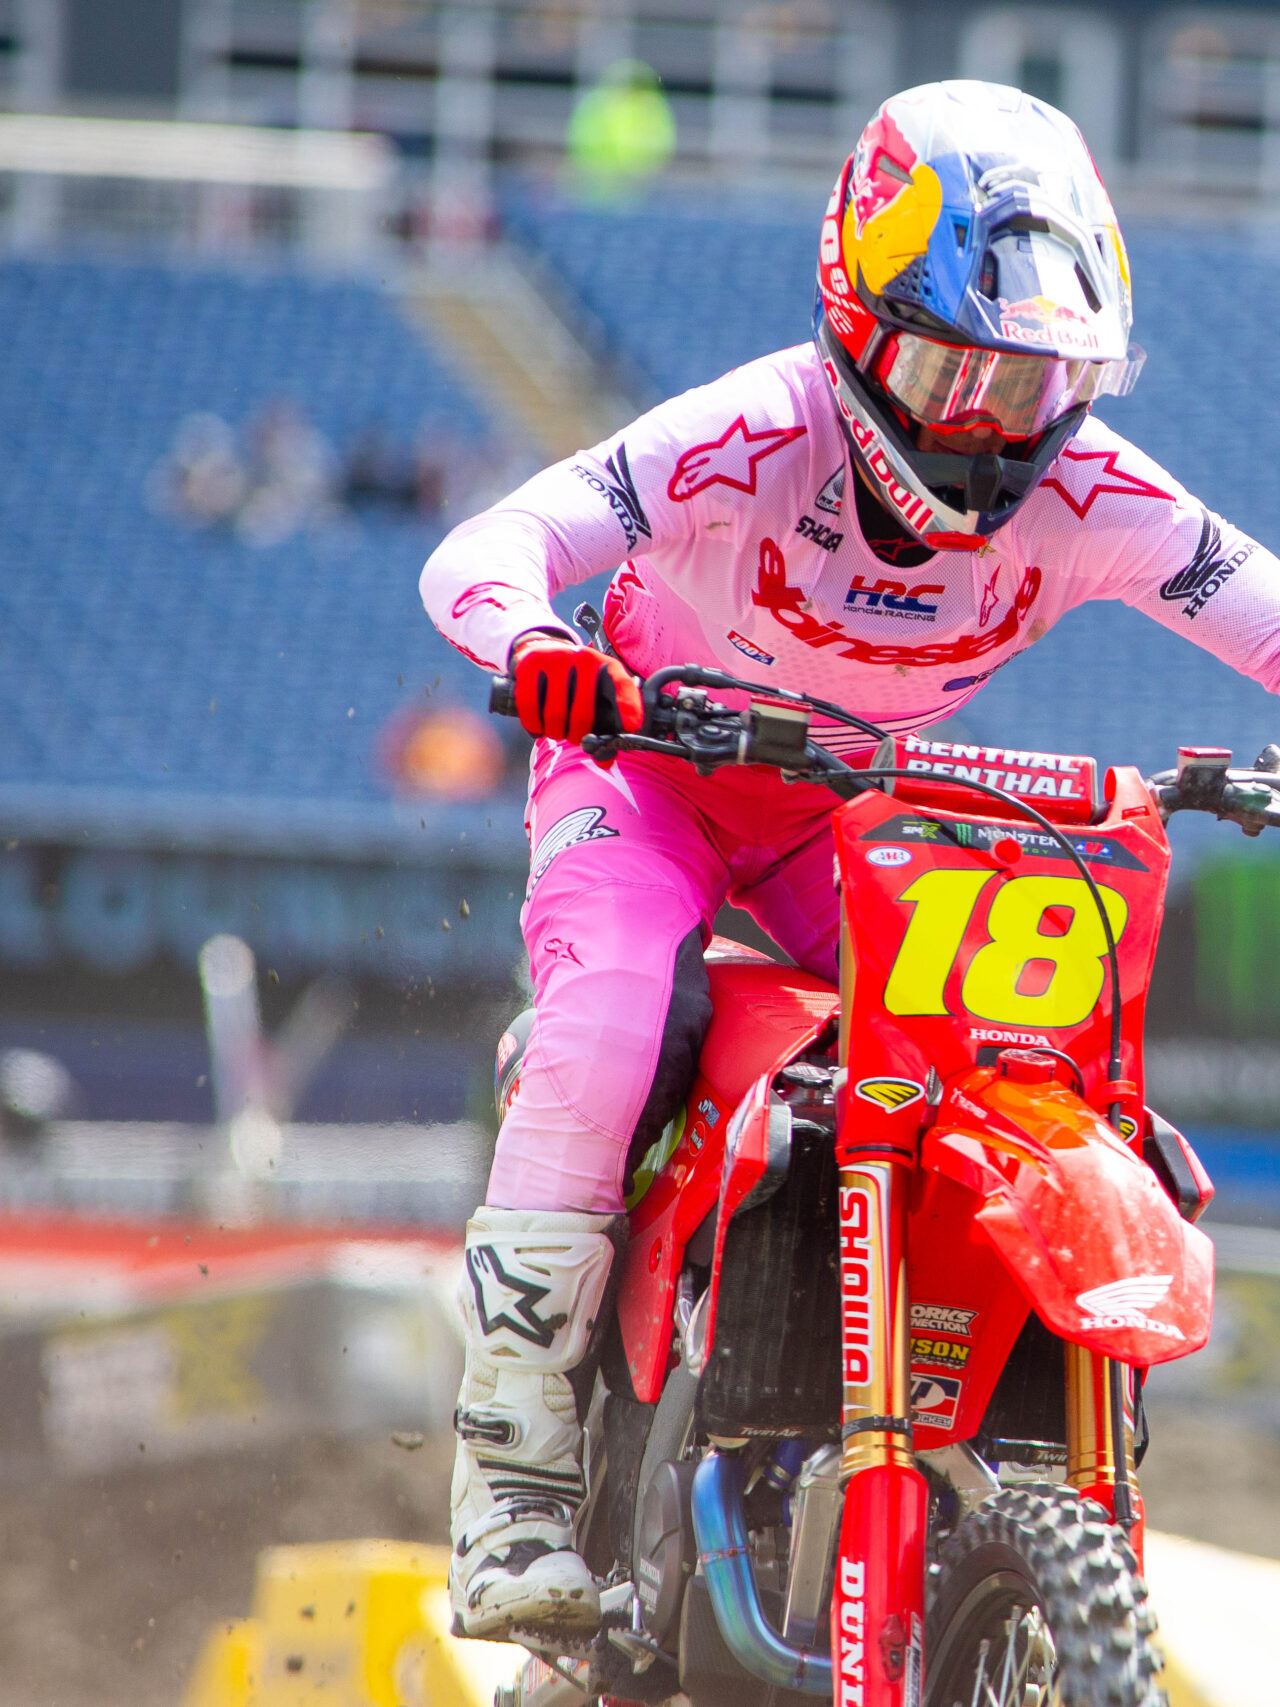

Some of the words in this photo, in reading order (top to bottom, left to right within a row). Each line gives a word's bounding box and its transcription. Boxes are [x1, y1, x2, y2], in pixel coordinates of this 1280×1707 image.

[1000, 320, 1053, 343] Red
[1057, 330, 1099, 349] Bull
[570, 464, 638, 554] HONDA
[845, 575, 946, 614] HRC
[1182, 543, 1260, 620] HONDA
[884, 610, 937, 622] RACING
[729, 634, 771, 663] 100%
[977, 828, 1062, 849] MONSTER
[884, 868, 1129, 1028] 18
[969, 1028, 1052, 1047] HONDA
[840, 1187, 875, 1388] SHOWA
[911, 1305, 975, 1324] ORKS
[911, 1318, 969, 1335] NECTION
[1080, 1316, 1187, 1340] HONDA
[910, 1338, 971, 1361] SON
[740, 1427, 775, 1437] Twin
[776, 1428, 801, 1437] Air
[841, 1556, 864, 1707] DUNL
